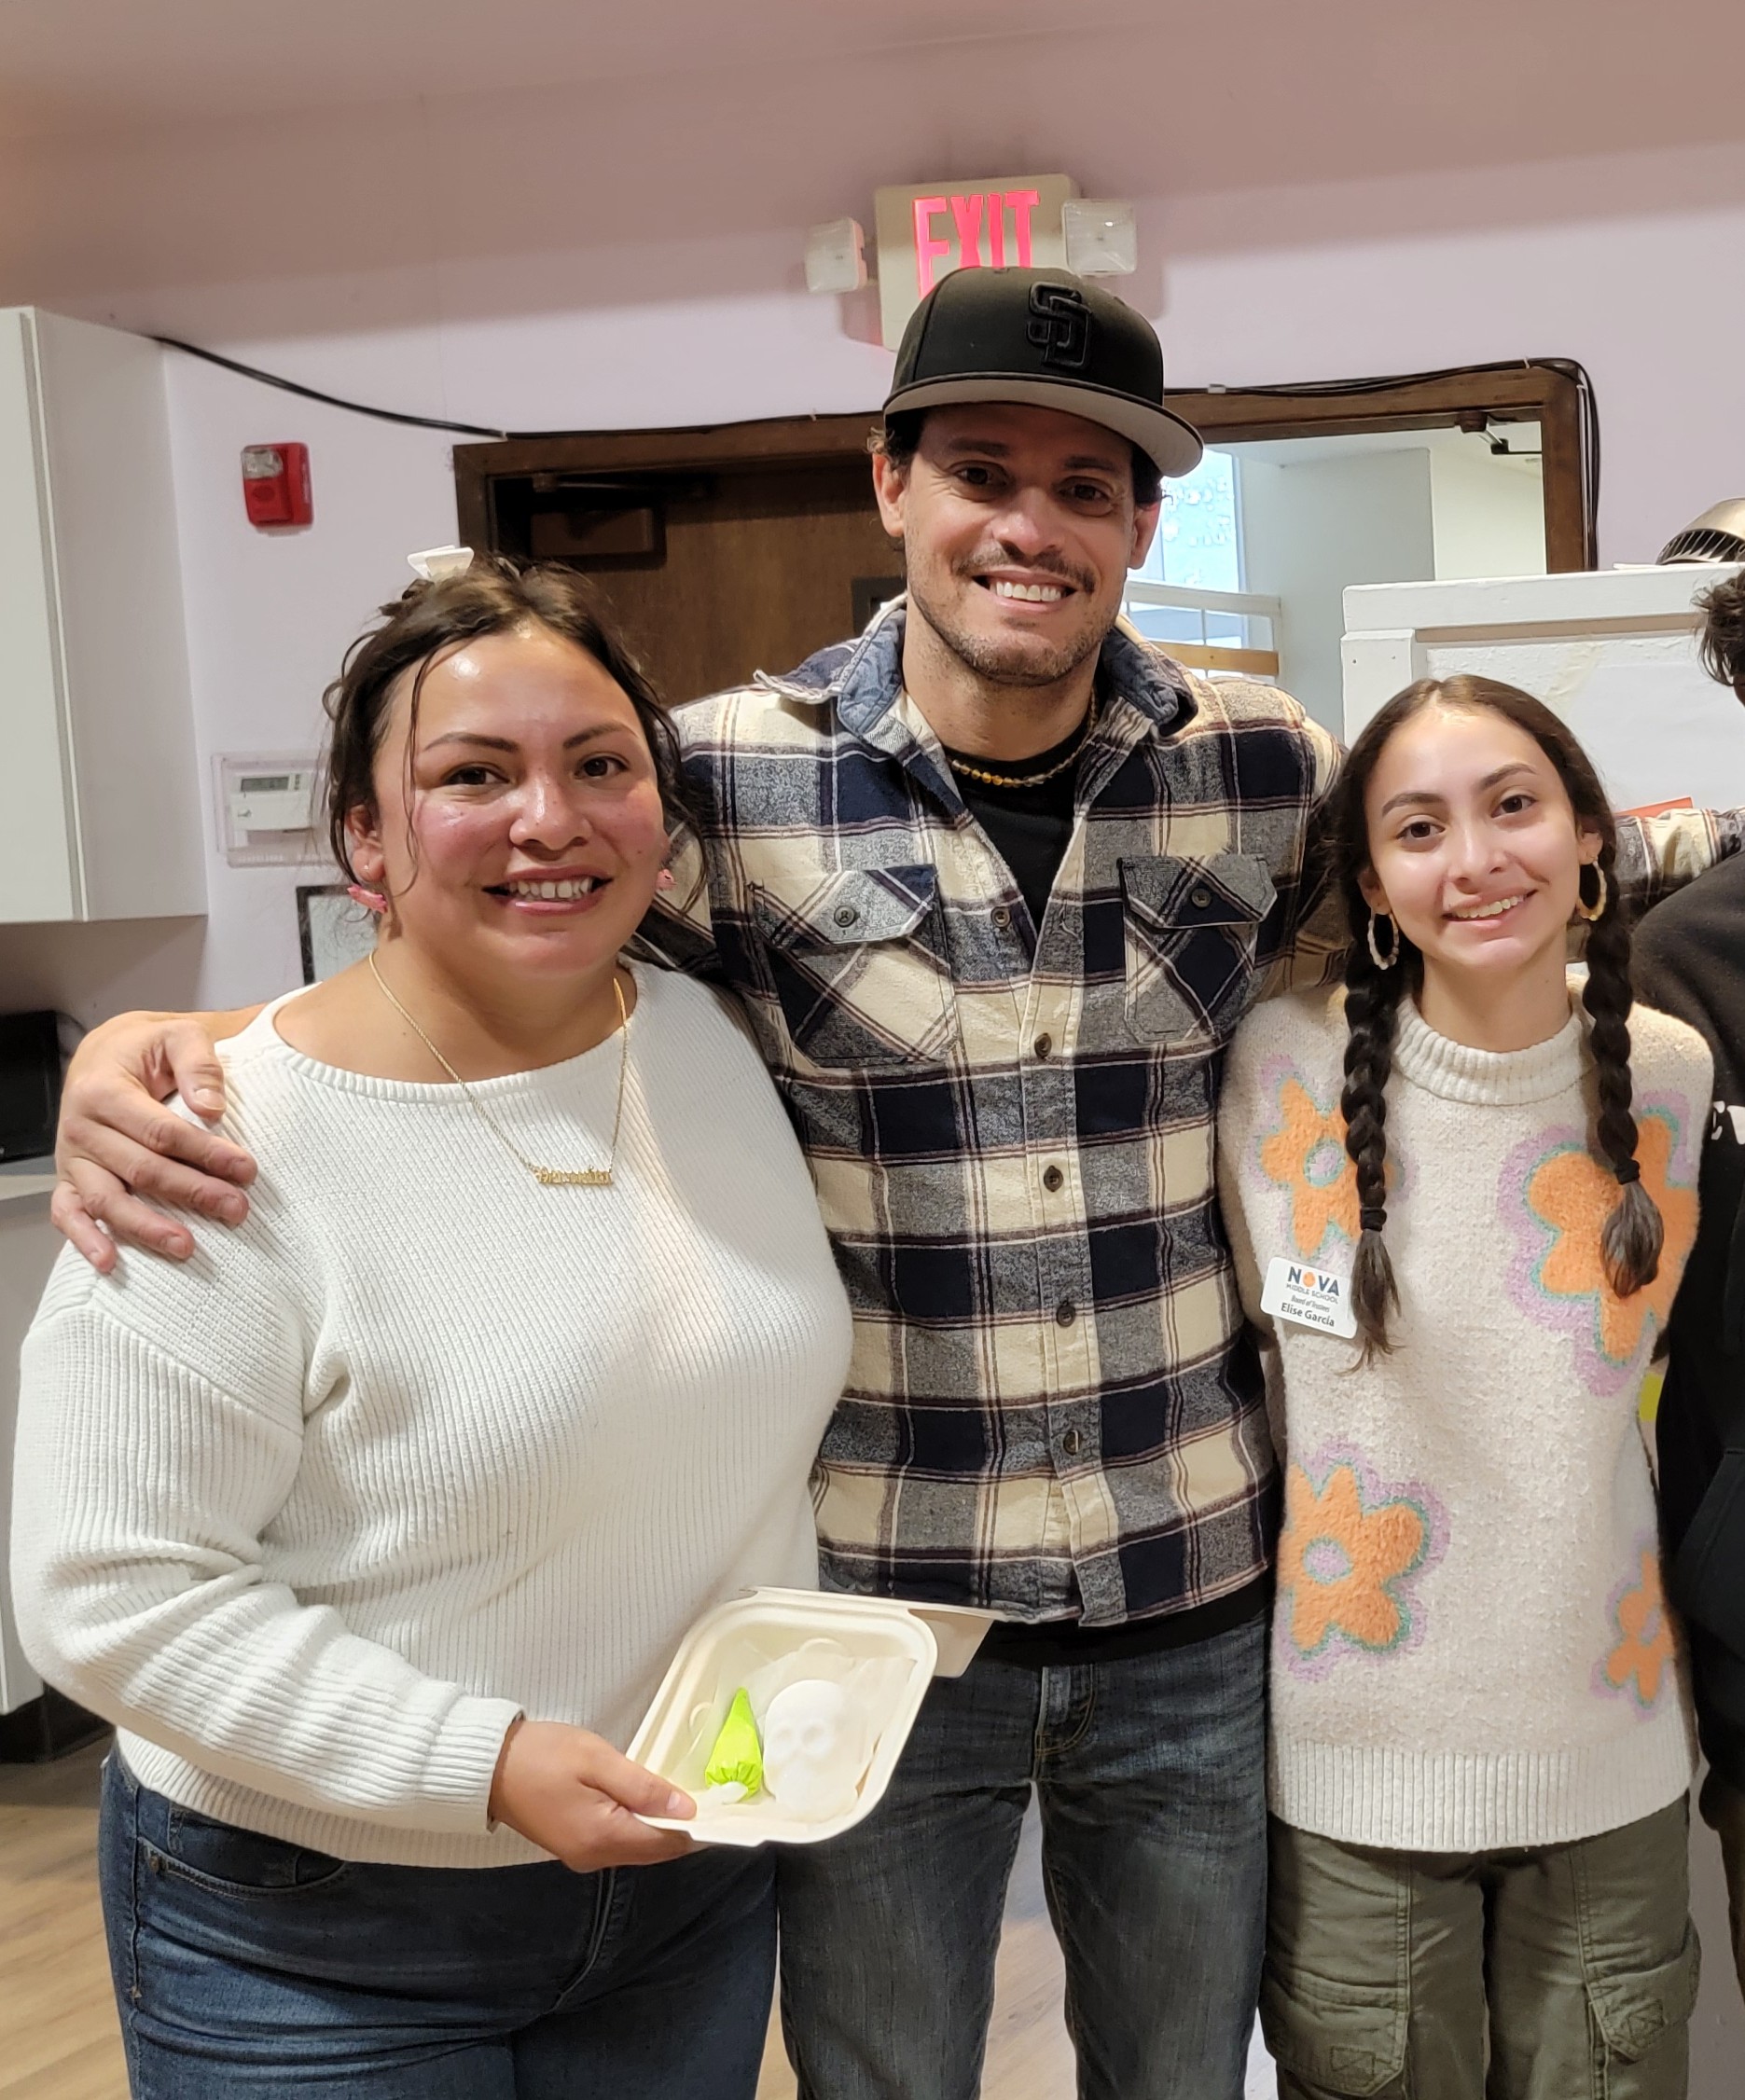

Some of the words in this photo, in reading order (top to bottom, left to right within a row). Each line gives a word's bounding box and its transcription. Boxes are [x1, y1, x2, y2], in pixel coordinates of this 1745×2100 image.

[912, 189, 1040, 300] EXIT
[1286, 1283, 1310, 1294] MIDDLE
[1311, 1290, 1338, 1304] SCHOOL
[1287, 1265, 1339, 1296] NOVA
[1281, 1302, 1303, 1317] Elise
